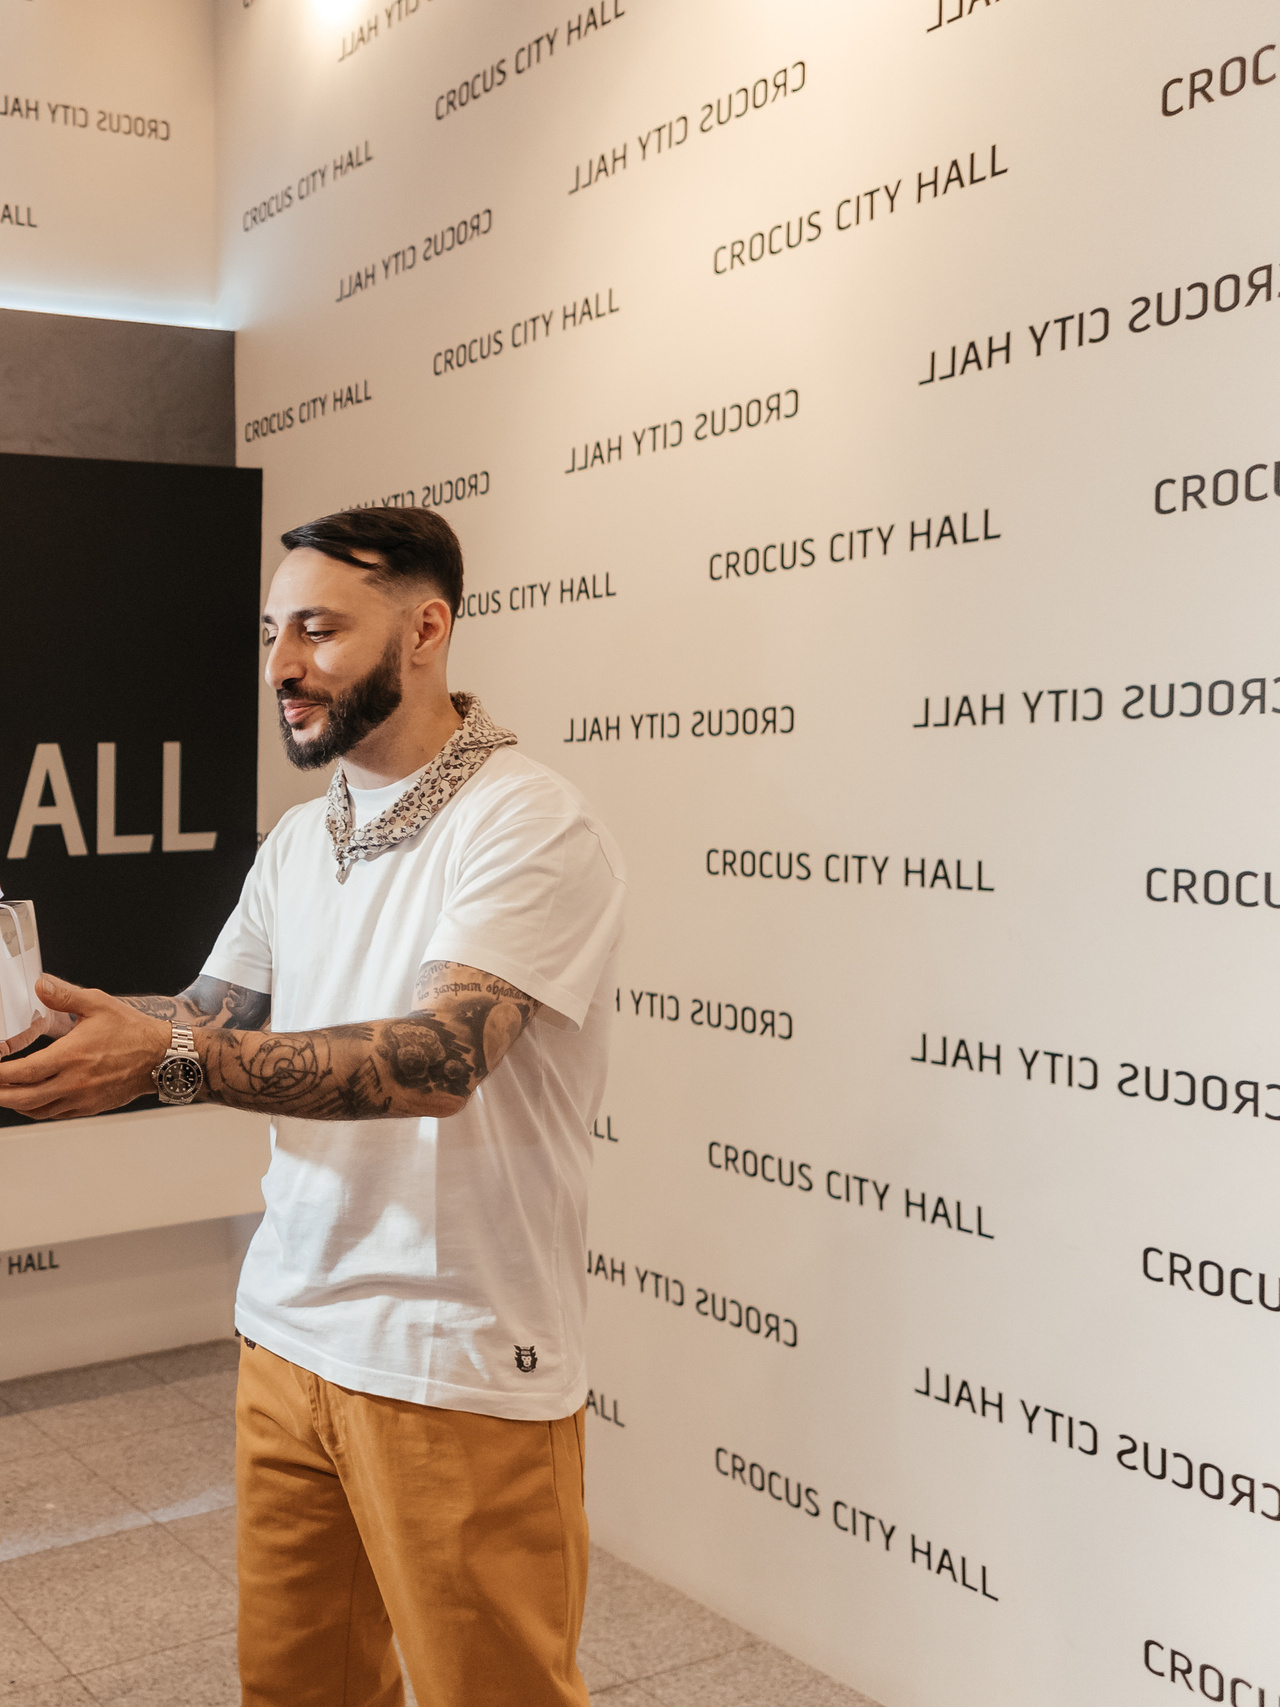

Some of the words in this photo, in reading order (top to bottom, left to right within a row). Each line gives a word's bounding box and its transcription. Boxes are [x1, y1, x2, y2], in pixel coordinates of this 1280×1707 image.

[435, 58, 508, 121] CROCUS
[514, 27, 559, 76] CITY
[566, 0, 626, 46] HALL
[1161, 44, 1277, 118] CROC
[242, 185, 294, 233] CROCUS
[297, 164, 329, 201] CITY
[332, 140, 374, 181] HALL
[713, 210, 822, 276] CROCUS
[836, 179, 902, 232] CITY
[917, 144, 1009, 204] HALL
[432, 329, 504, 377] CROCUS
[511, 309, 554, 349] CITY
[562, 287, 620, 331] HALL
[244, 406, 295, 444] CROCUS
[298, 394, 328, 425] CITY
[332, 379, 373, 412] HALL
[1154, 460, 1280, 515] CROC
[709, 537, 816, 582] CROCUS
[829, 523, 895, 563] CITY
[909, 508, 1002, 552] HALL
[456, 589, 502, 620] OCUS
[509, 581, 551, 612] CITY
[559, 571, 617, 604] HALL
[706, 848, 812, 881] CROCUS
[824, 853, 890, 886] CITY
[904, 857, 995, 892] HALL
[1146, 867, 1280, 910] CROCU
[708, 1140, 814, 1193] CROCUS
[826, 1169, 890, 1212] CITY
[904, 1188, 995, 1240] HALL
[7, 1249, 60, 1276] HALL
[1142, 1246, 1280, 1313] CROCU
[585, 1388, 626, 1429] ALL
[714, 1446, 821, 1518] CROCUS
[832, 1500, 897, 1552] CITY
[910, 1533, 999, 1602] HALL
[1143, 1639, 1280, 1707] CROC
